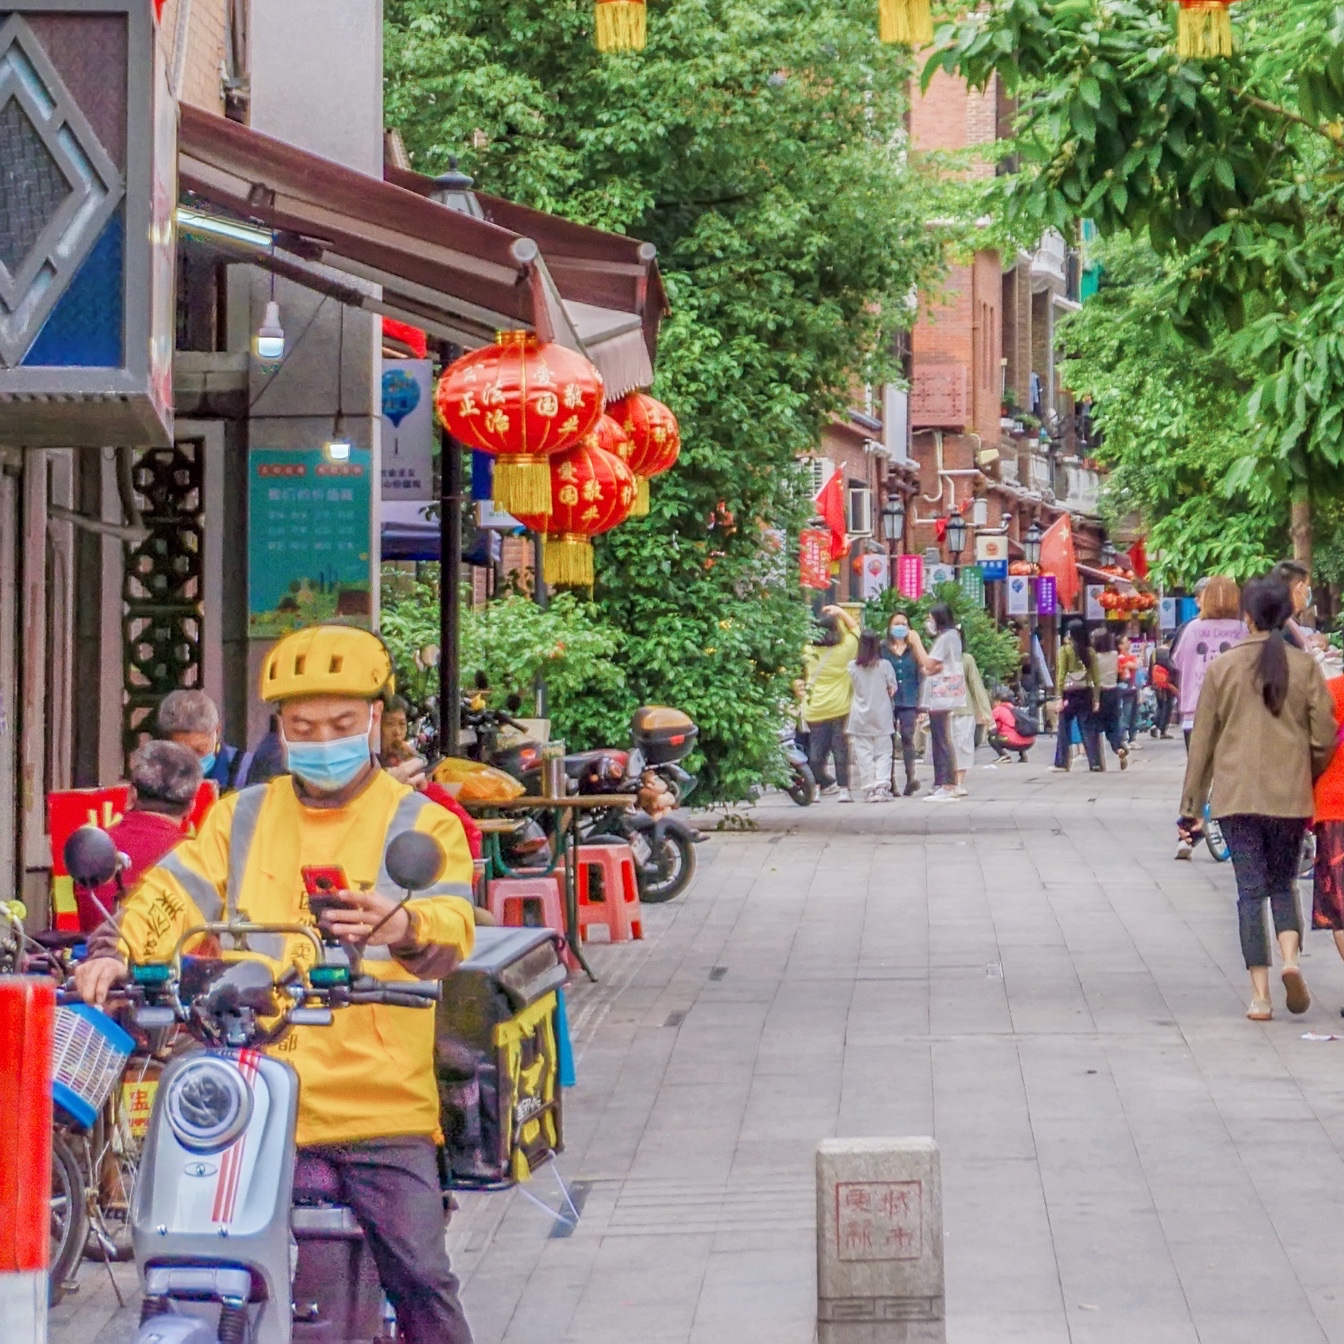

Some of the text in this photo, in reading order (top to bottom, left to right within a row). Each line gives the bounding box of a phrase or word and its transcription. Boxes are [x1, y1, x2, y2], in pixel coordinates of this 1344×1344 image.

[459, 363, 485, 417] 公正
[483, 379, 510, 434] 法治
[535, 365, 558, 417] 爱国
[558, 382, 586, 434] 敬业
[559, 462, 579, 507] 爱国
[581, 479, 604, 520] 敬业
